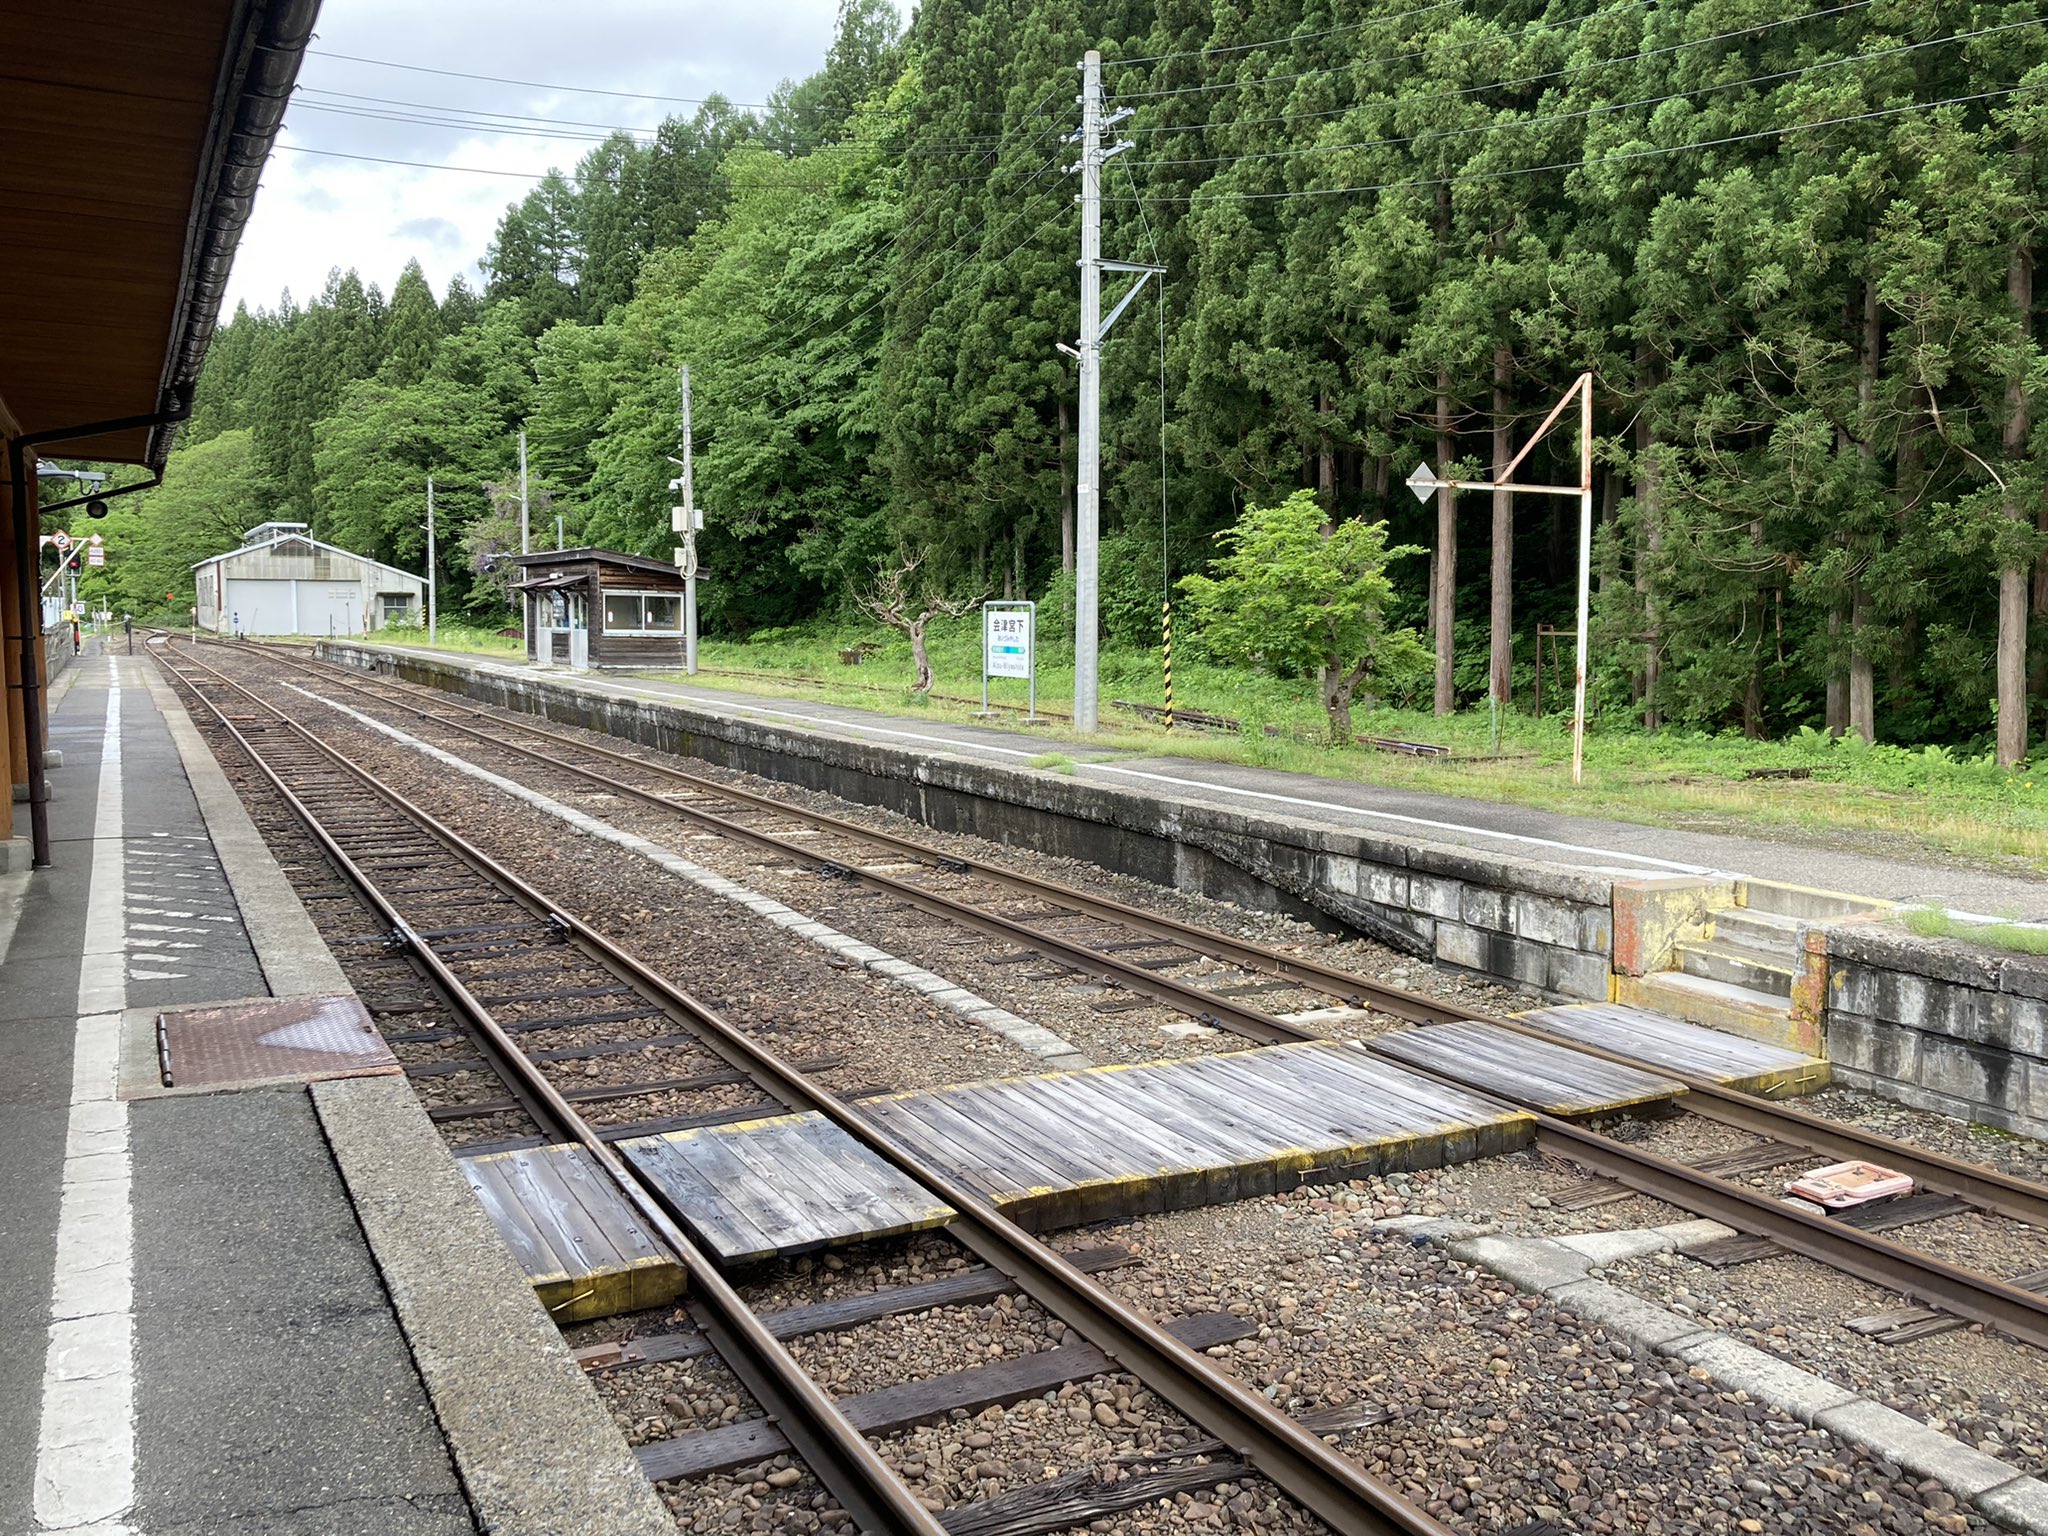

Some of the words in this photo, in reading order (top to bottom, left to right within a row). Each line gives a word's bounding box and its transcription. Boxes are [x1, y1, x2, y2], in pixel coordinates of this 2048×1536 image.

[58, 535, 65, 545] 2
[993, 619, 1024, 632] 会津宮下
